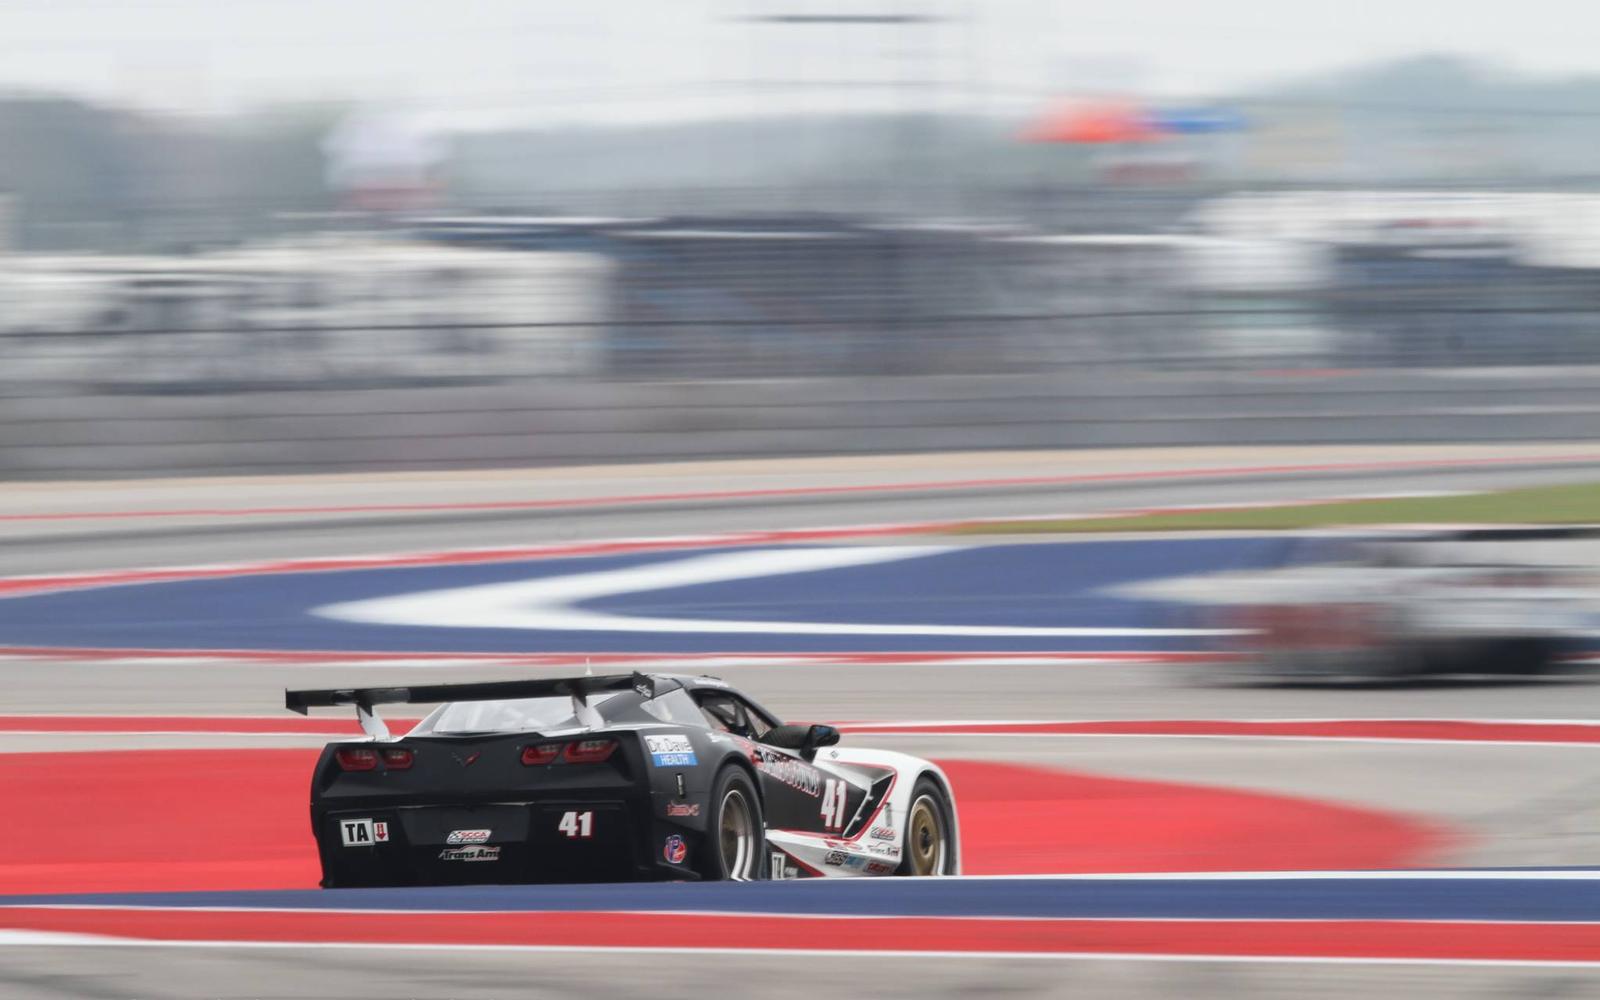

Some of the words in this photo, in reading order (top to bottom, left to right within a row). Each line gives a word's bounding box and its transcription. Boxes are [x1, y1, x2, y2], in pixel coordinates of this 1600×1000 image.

[820, 778, 847, 830] 41
[344, 823, 370, 842] TA
[558, 811, 593, 838] 41
